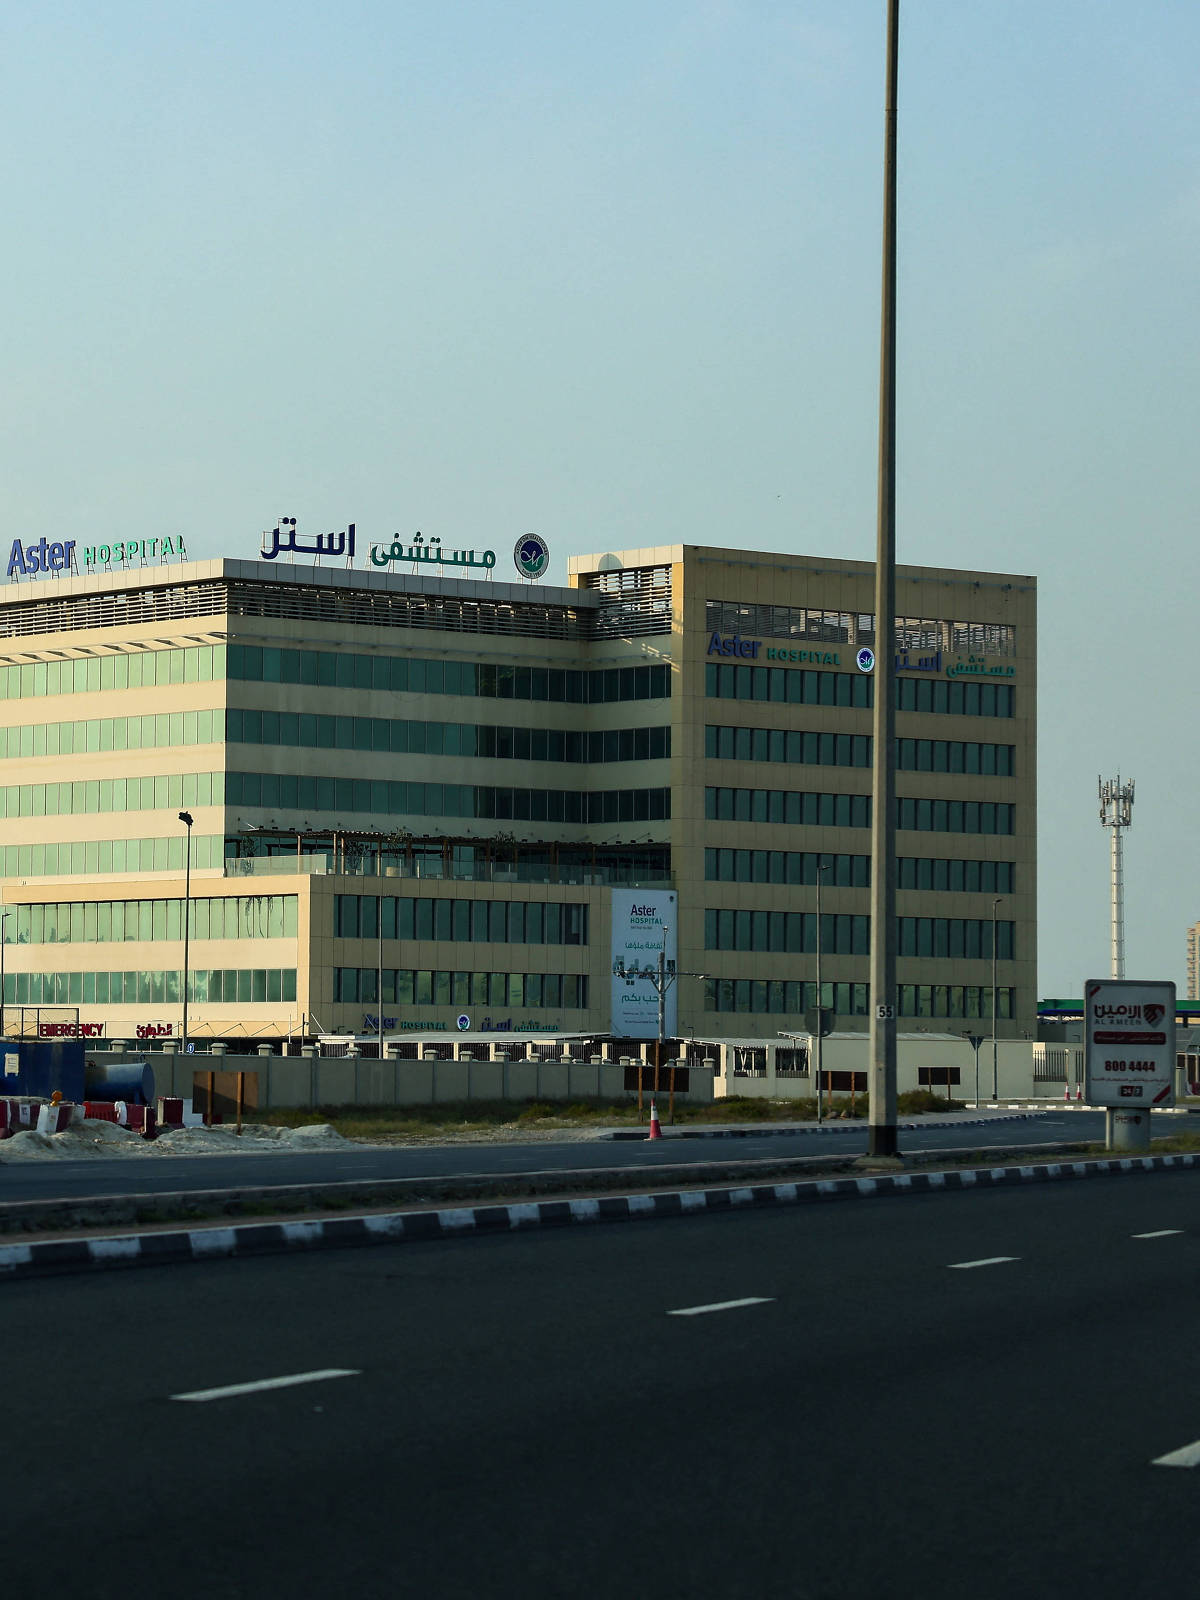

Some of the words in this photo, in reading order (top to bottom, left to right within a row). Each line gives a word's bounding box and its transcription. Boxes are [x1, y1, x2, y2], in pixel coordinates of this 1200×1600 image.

[261, 517, 355, 560] استر
[7, 537, 75, 577] Aster
[83, 535, 186, 566] HOSPITAL
[371, 532, 496, 568] مستشفى
[708, 632, 762, 659] Aster
[767, 647, 841, 665] HOSPITAL
[946, 655, 1016, 678] مستشفى
[630, 904, 657, 917] Aster
[630, 917, 663, 925] HOSPITAL
[39, 1023, 104, 1037] EMERGENCY
[363, 1013, 400, 1030] Aser
[400, 1020, 448, 1031] HOSPITAL
[1104, 1061, 1127, 1072] 800
[1128, 1061, 1156, 1072] 4444
